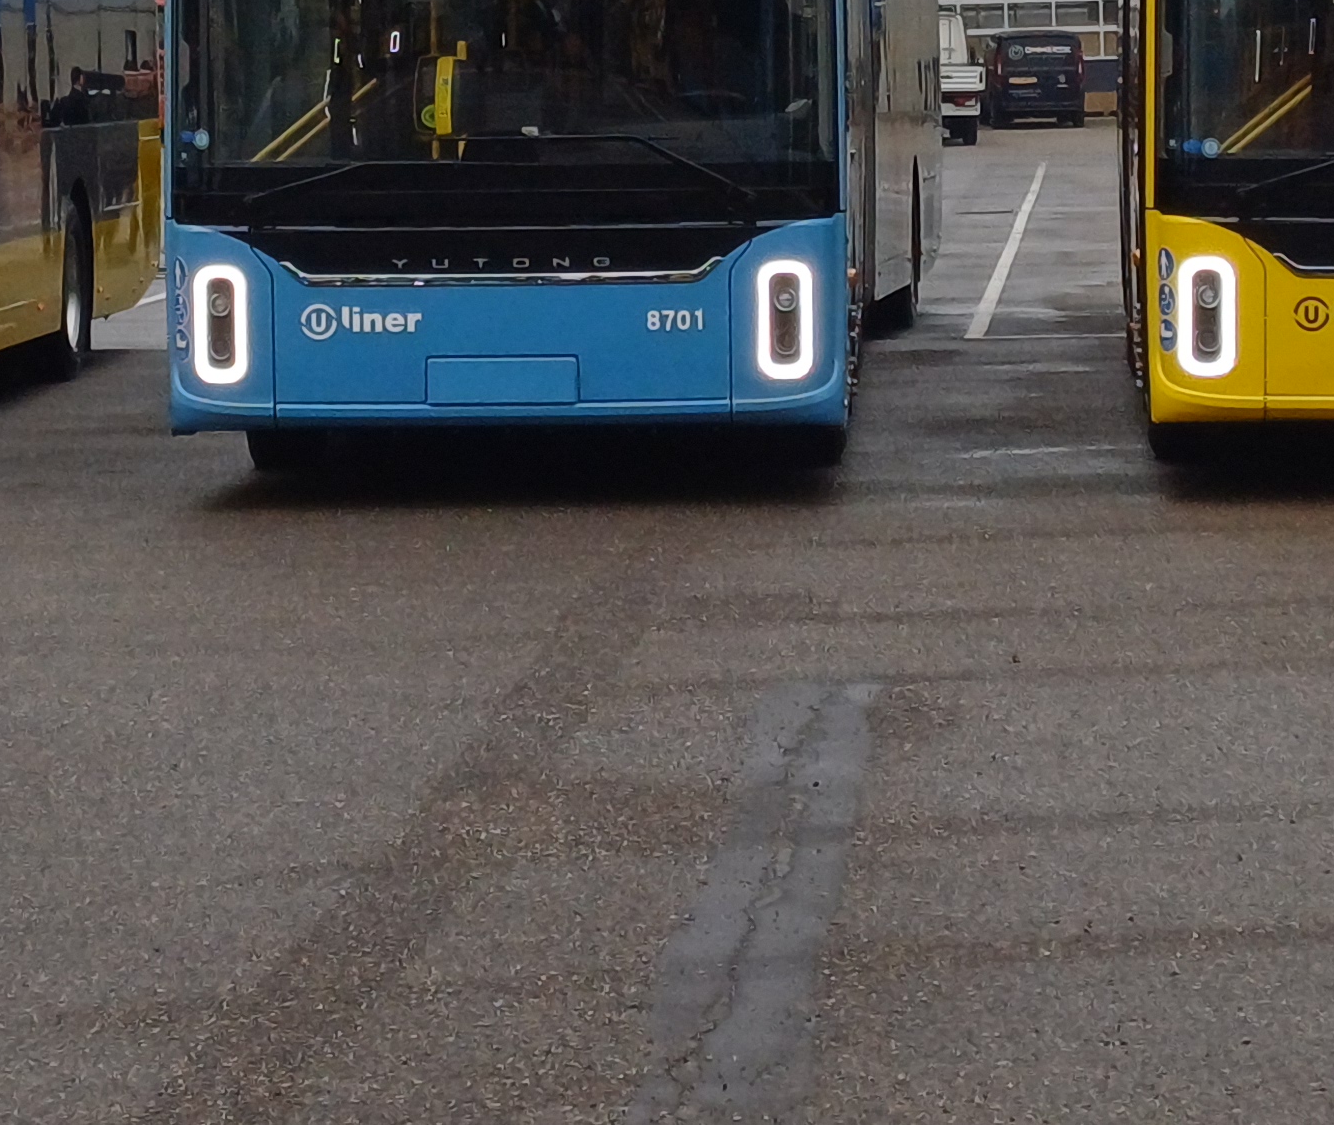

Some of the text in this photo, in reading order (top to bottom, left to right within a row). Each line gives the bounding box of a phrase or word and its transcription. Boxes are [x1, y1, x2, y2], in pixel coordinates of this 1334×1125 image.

[391, 256, 611, 269] YUTONG
[341, 305, 423, 333] liner
[645, 307, 704, 332] 8701
